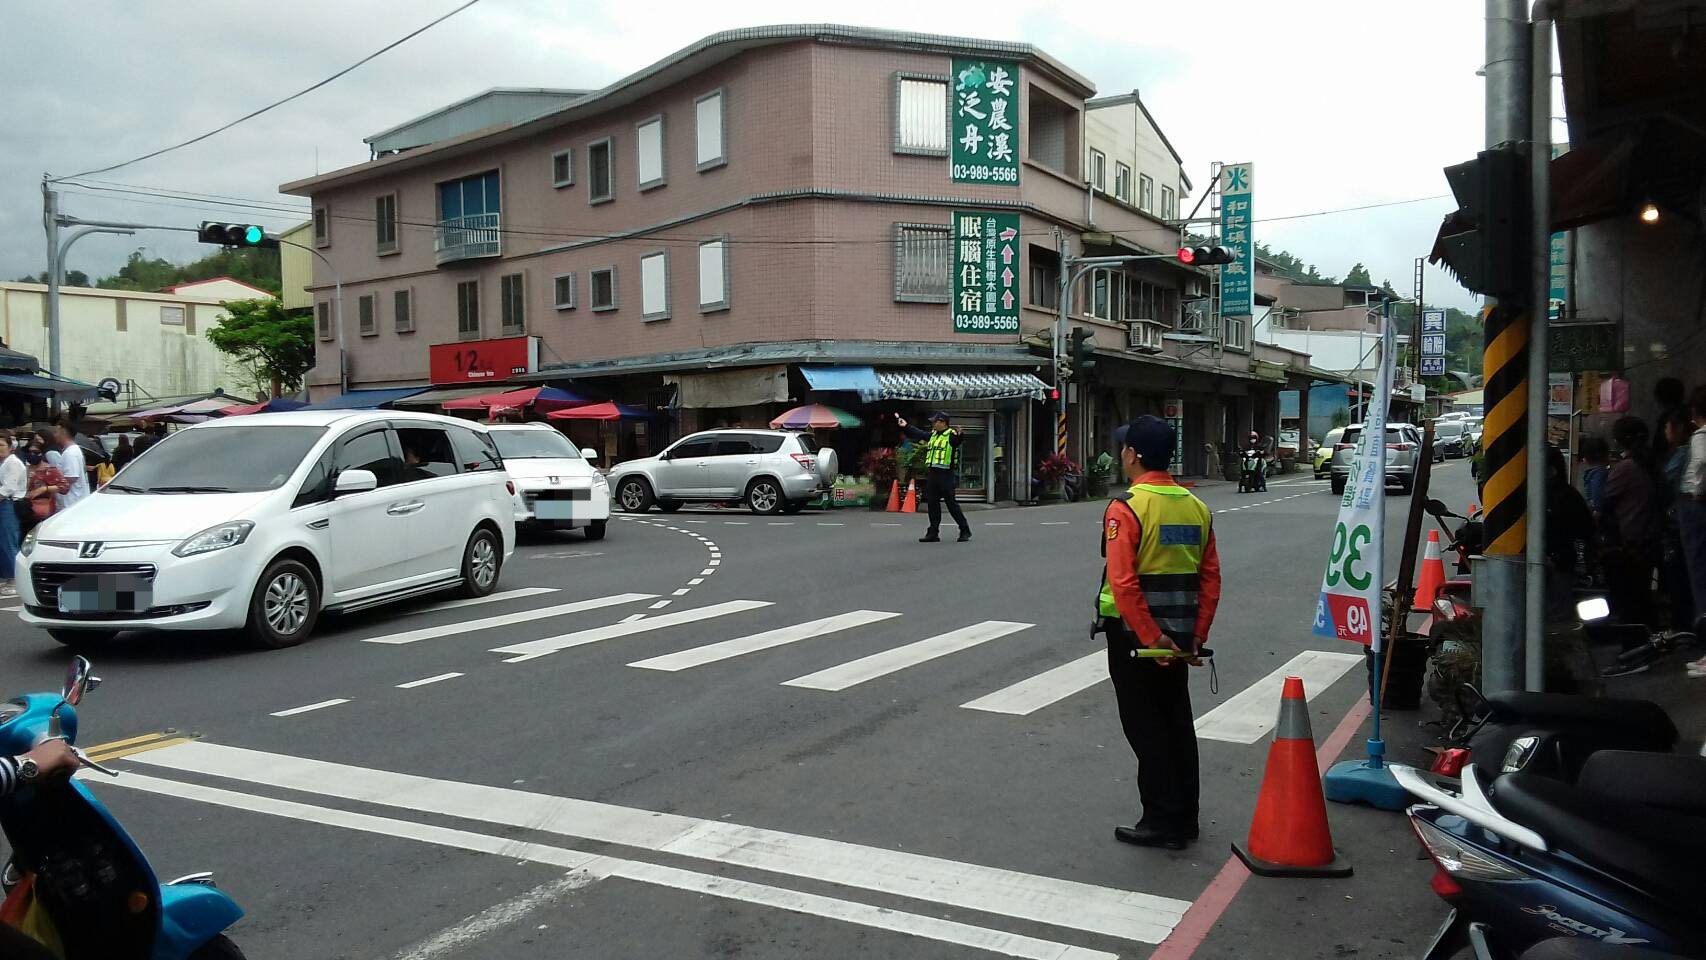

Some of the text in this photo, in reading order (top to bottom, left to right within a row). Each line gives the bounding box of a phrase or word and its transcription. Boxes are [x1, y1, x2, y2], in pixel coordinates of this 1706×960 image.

[986, 67, 1013, 162] 安農溪
[954, 164, 1017, 181] 03-989-5566
[1225, 168, 1248, 191] 米
[960, 216, 982, 312] 眠腦住宿
[956, 315, 1018, 330] 03-989-5566
